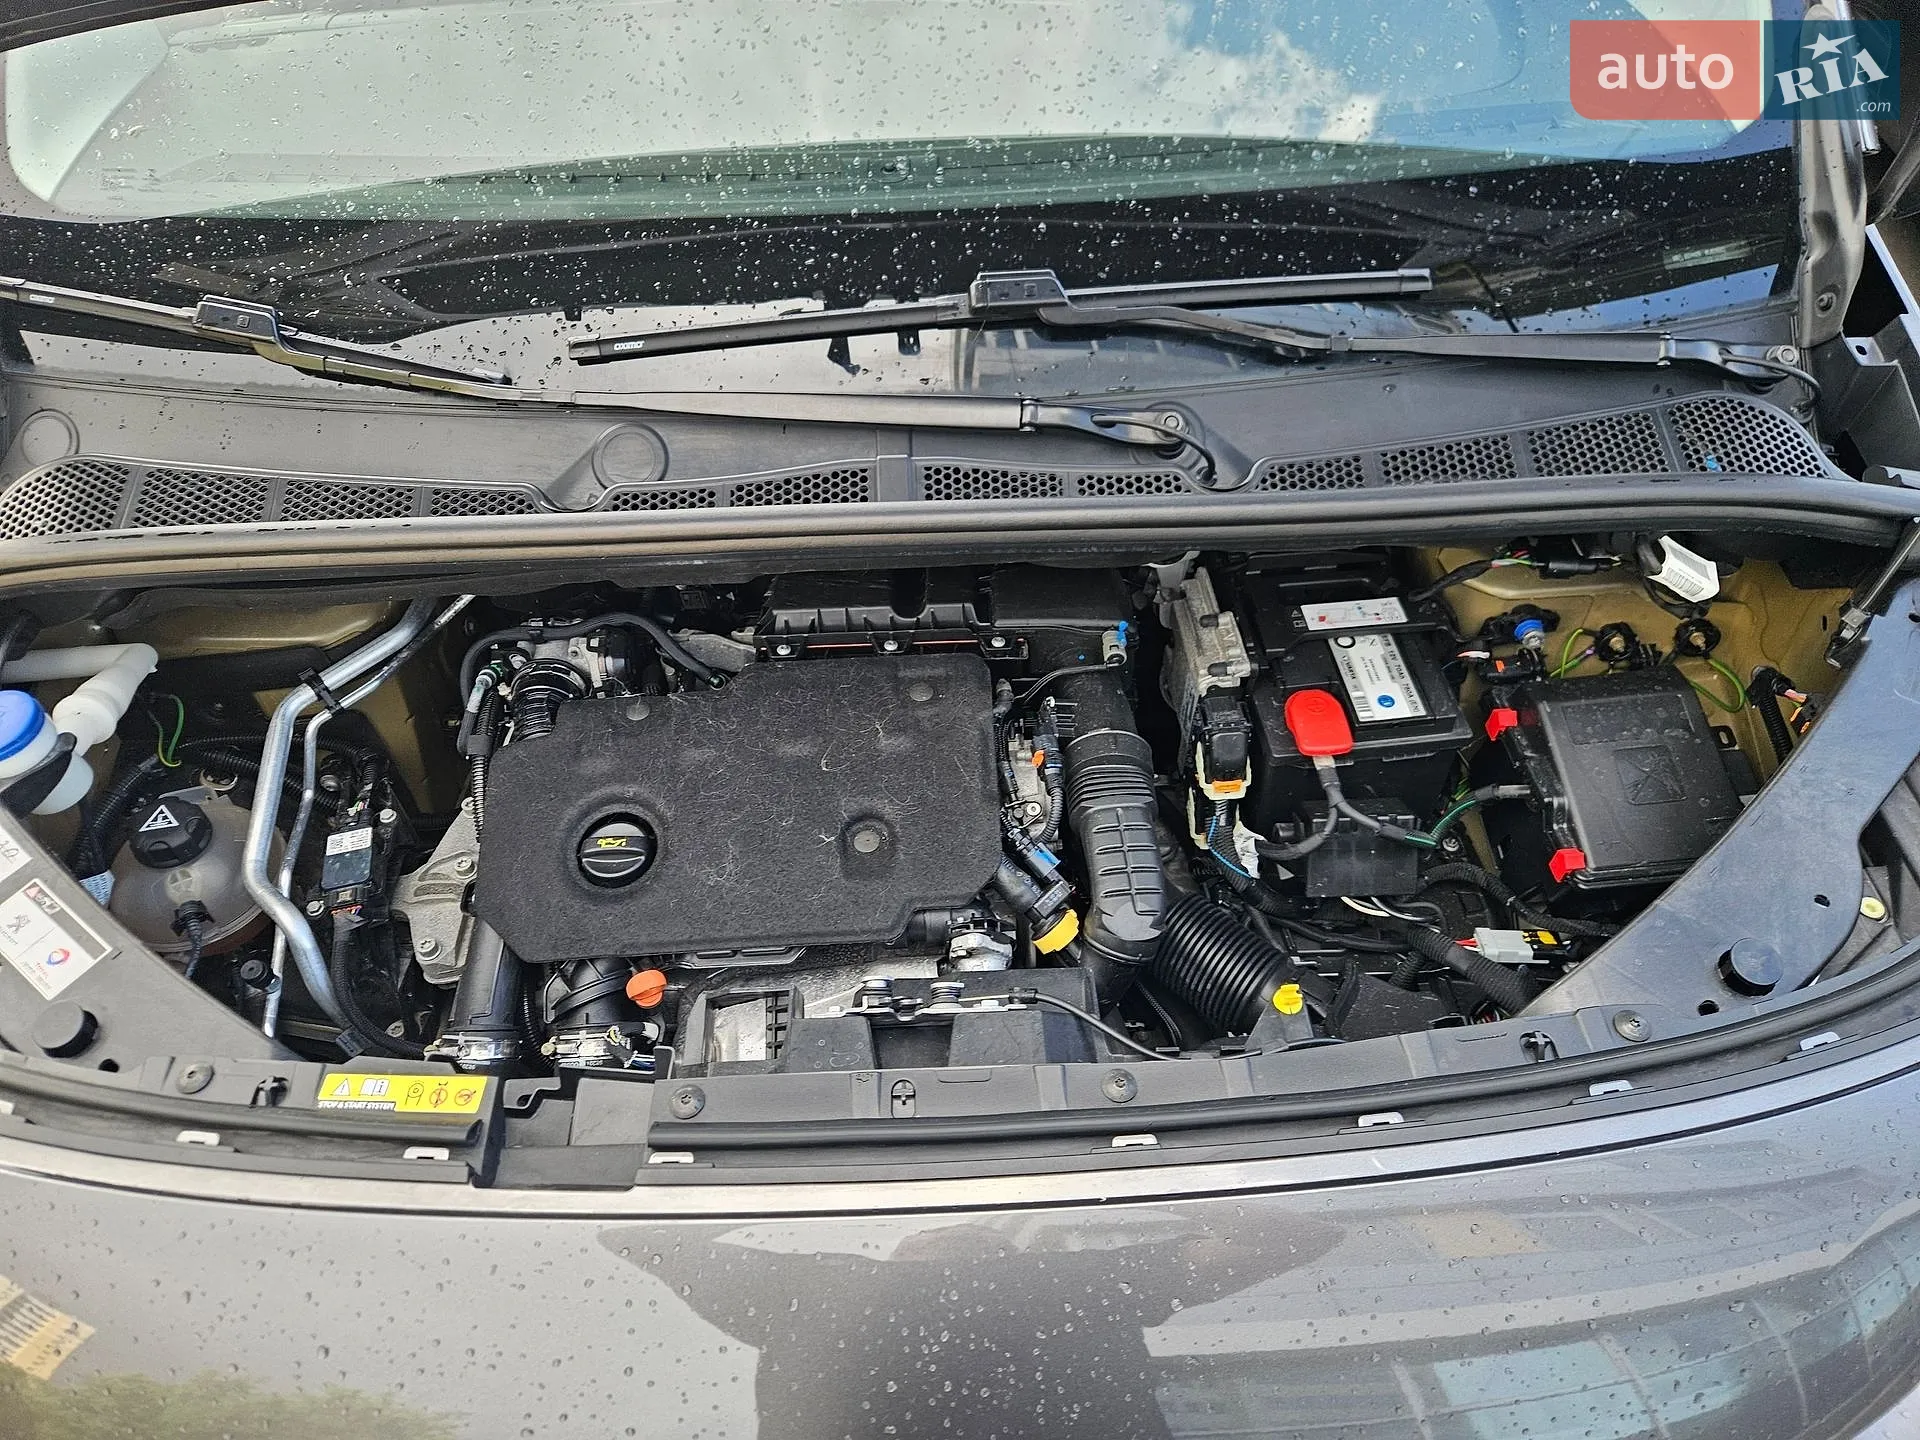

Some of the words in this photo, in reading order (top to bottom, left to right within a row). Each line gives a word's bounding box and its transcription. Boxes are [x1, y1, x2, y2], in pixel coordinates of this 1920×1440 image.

[317, 1102, 337, 1110] STOP
[344, 1101, 367, 1109] START
[367, 1102, 395, 1111] SYSTEM
